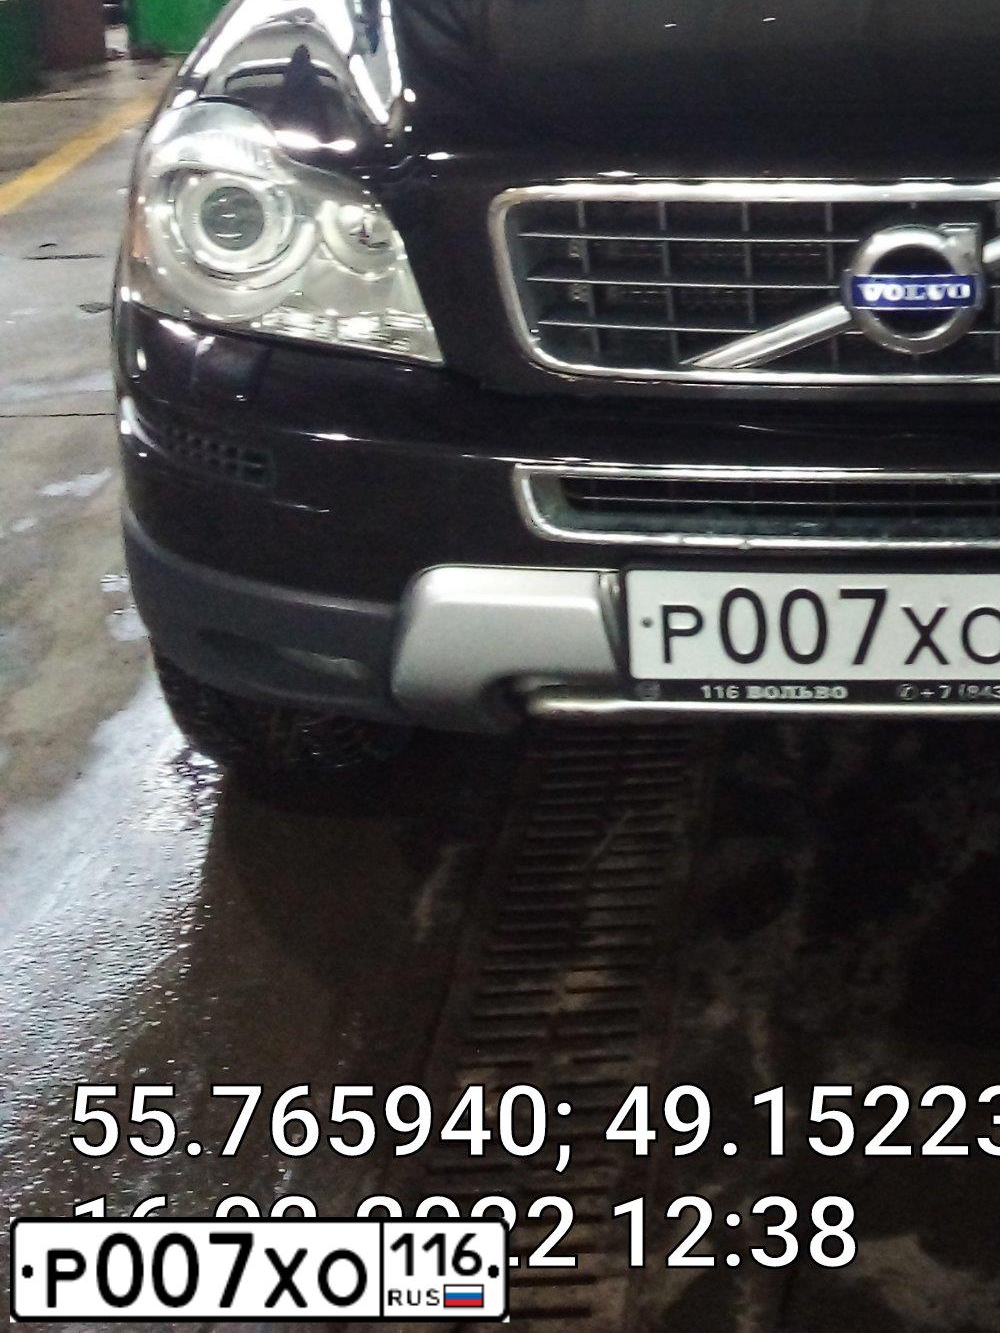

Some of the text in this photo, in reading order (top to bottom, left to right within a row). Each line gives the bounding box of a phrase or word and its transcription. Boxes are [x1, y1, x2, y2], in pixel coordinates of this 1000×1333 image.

[857, 283, 971, 302] VOLVO
[700, 685, 740, 699] 116
[746, 686, 848, 699] ВОЛЬВО
